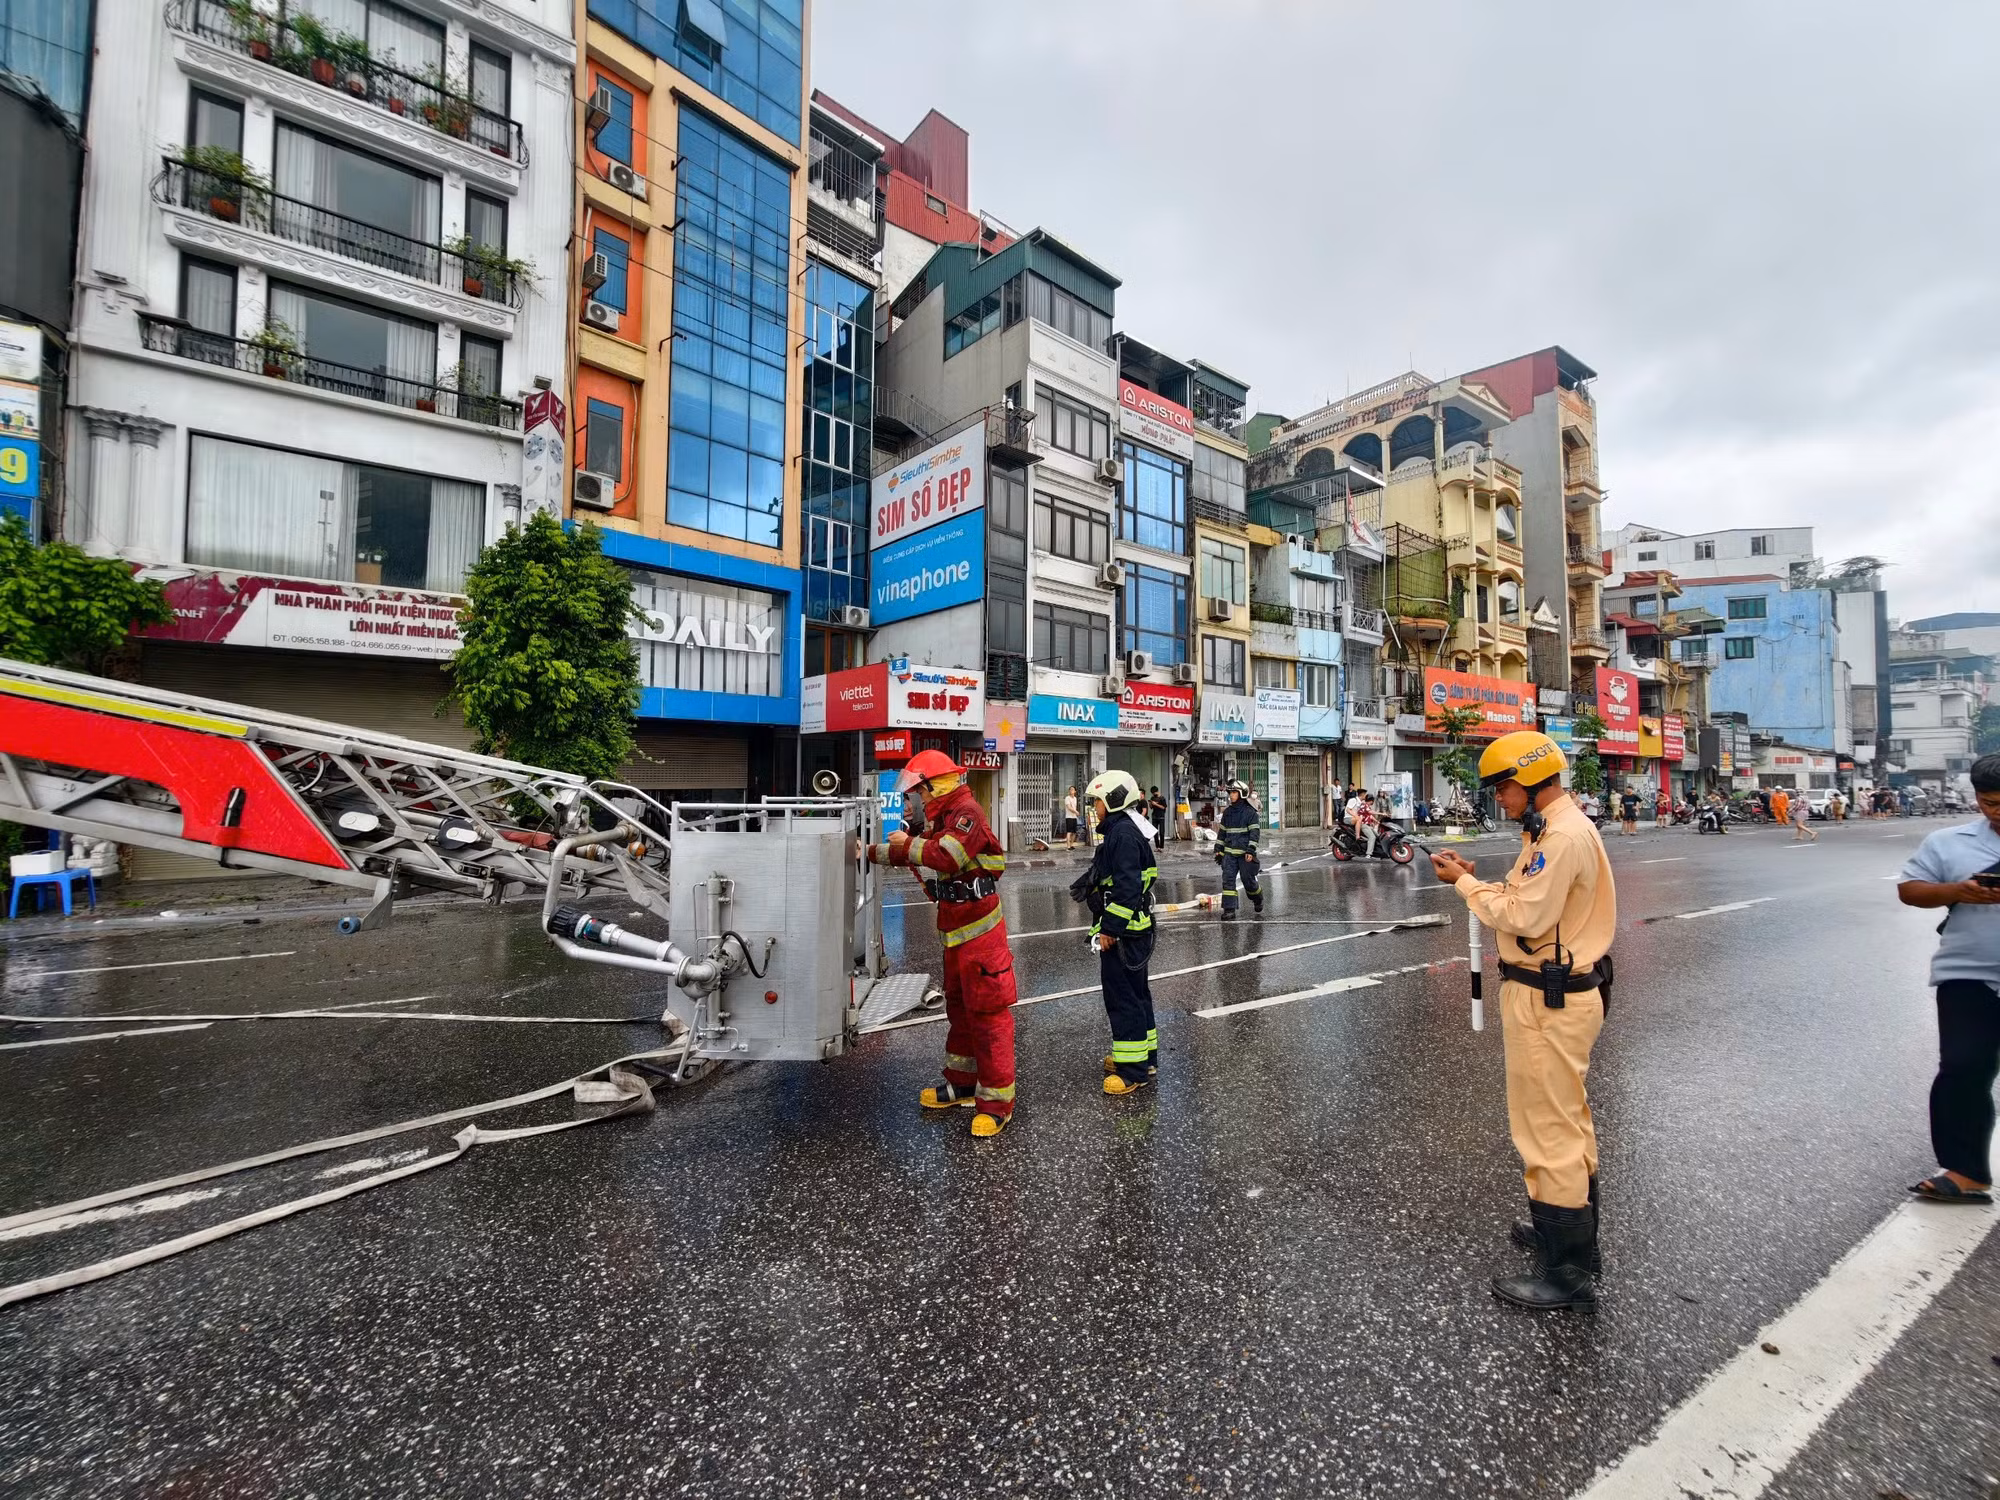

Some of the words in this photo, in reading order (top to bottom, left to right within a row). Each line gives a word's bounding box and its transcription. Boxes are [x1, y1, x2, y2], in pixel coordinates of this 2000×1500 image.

[1139, 398, 1191, 430] ARISTON
[877, 497, 906, 537] SIM
[911, 474, 935, 522] SỐ
[937, 466, 972, 513] ĐẸP
[877, 560, 970, 605] vinaphone
[173, 608, 203, 618] ANH
[274, 592, 303, 608] NHÀ
[305, 596, 341, 612] PHÂN
[374, 602, 398, 619] PHỤ
[399, 604, 426, 621] KIỆN
[428, 608, 455, 622] INOX
[349, 618, 373, 634] LỚN
[375, 620, 404, 636] NHẤT
[406, 623, 435, 639] MIỀN
[291, 635, 346, 647] 0965.158.188
[350, 640, 412, 652] 024.666.055.99
[840, 684, 874, 701] viettel
[907, 691, 930, 710] SIM
[931, 688, 947, 711] SỐ
[949, 694, 970, 716] ĐẸP
[1135, 694, 1191, 710] ARISTON
[852, 702, 874, 711] telecom
[1057, 702, 1096, 723] INAX
[1210, 701, 1246, 724] INAX
[1517, 742, 1554, 768] CSGT
[880, 791, 902, 808] 575
